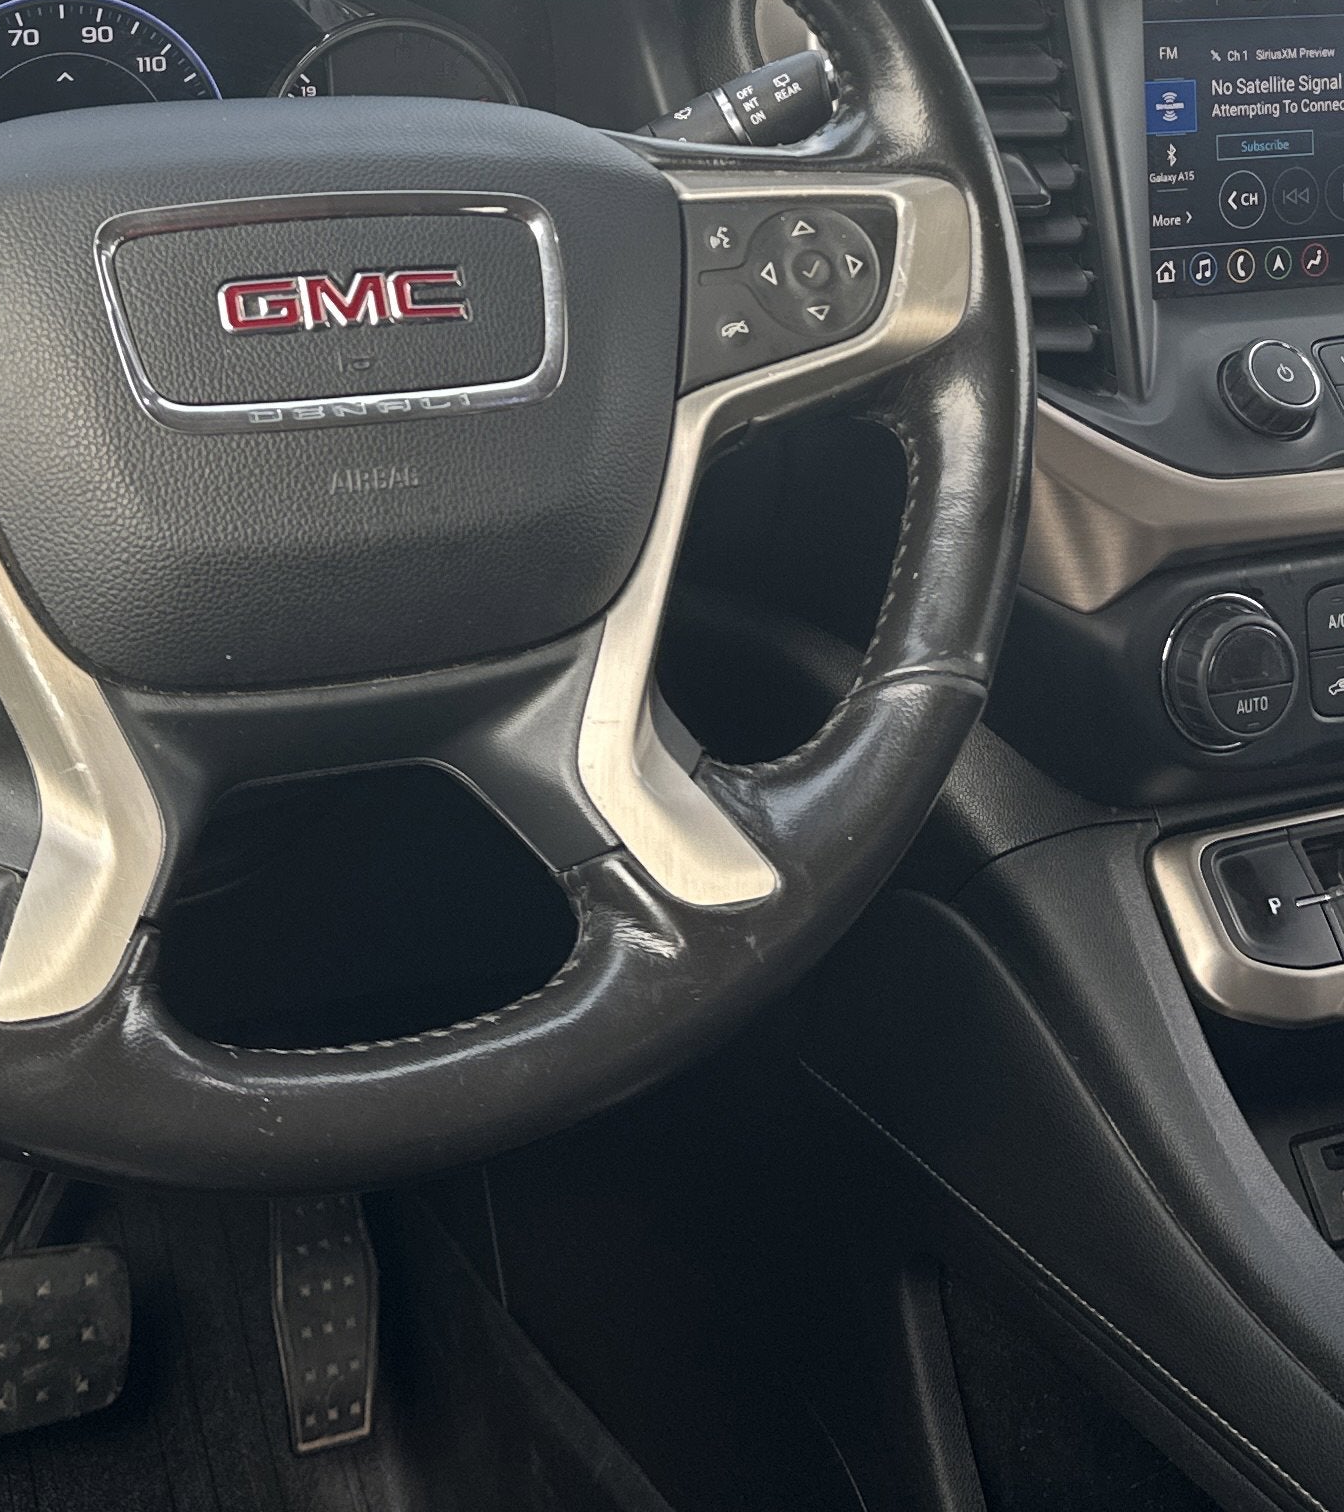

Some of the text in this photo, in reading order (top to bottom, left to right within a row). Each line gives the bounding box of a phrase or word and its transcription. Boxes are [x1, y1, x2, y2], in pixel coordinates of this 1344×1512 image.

[8, 28, 40, 46] 70
[81, 25, 114, 43] 90
[1159, 47, 1178, 60] FM
[1227, 50, 1249, 62] Ch 1
[1256, 47, 1335, 61] SiriusXM Preview
[136, 56, 167, 73] 110
[300, 85, 317, 97] 19
[773, 82, 802, 101] REAR
[1211, 73, 1343, 95] No Satellite Signal
[736, 86, 754, 100] OFF
[742, 97, 760, 112] INT
[1211, 101, 1280, 118] Attempting
[1282, 99, 1298, 114] To
[750, 110, 767, 125] ON
[1241, 140, 1290, 153] Subscribe
[1149, 170, 1195, 184] Galaxy A15
[1240, 193, 1258, 206] CH
[1152, 215, 1182, 227] More
[218, 269, 468, 334] GMC
[329, 465, 420, 495] AIRBAG
[1236, 696, 1268, 715] AUTO
[1268, 897, 1282, 915] P
